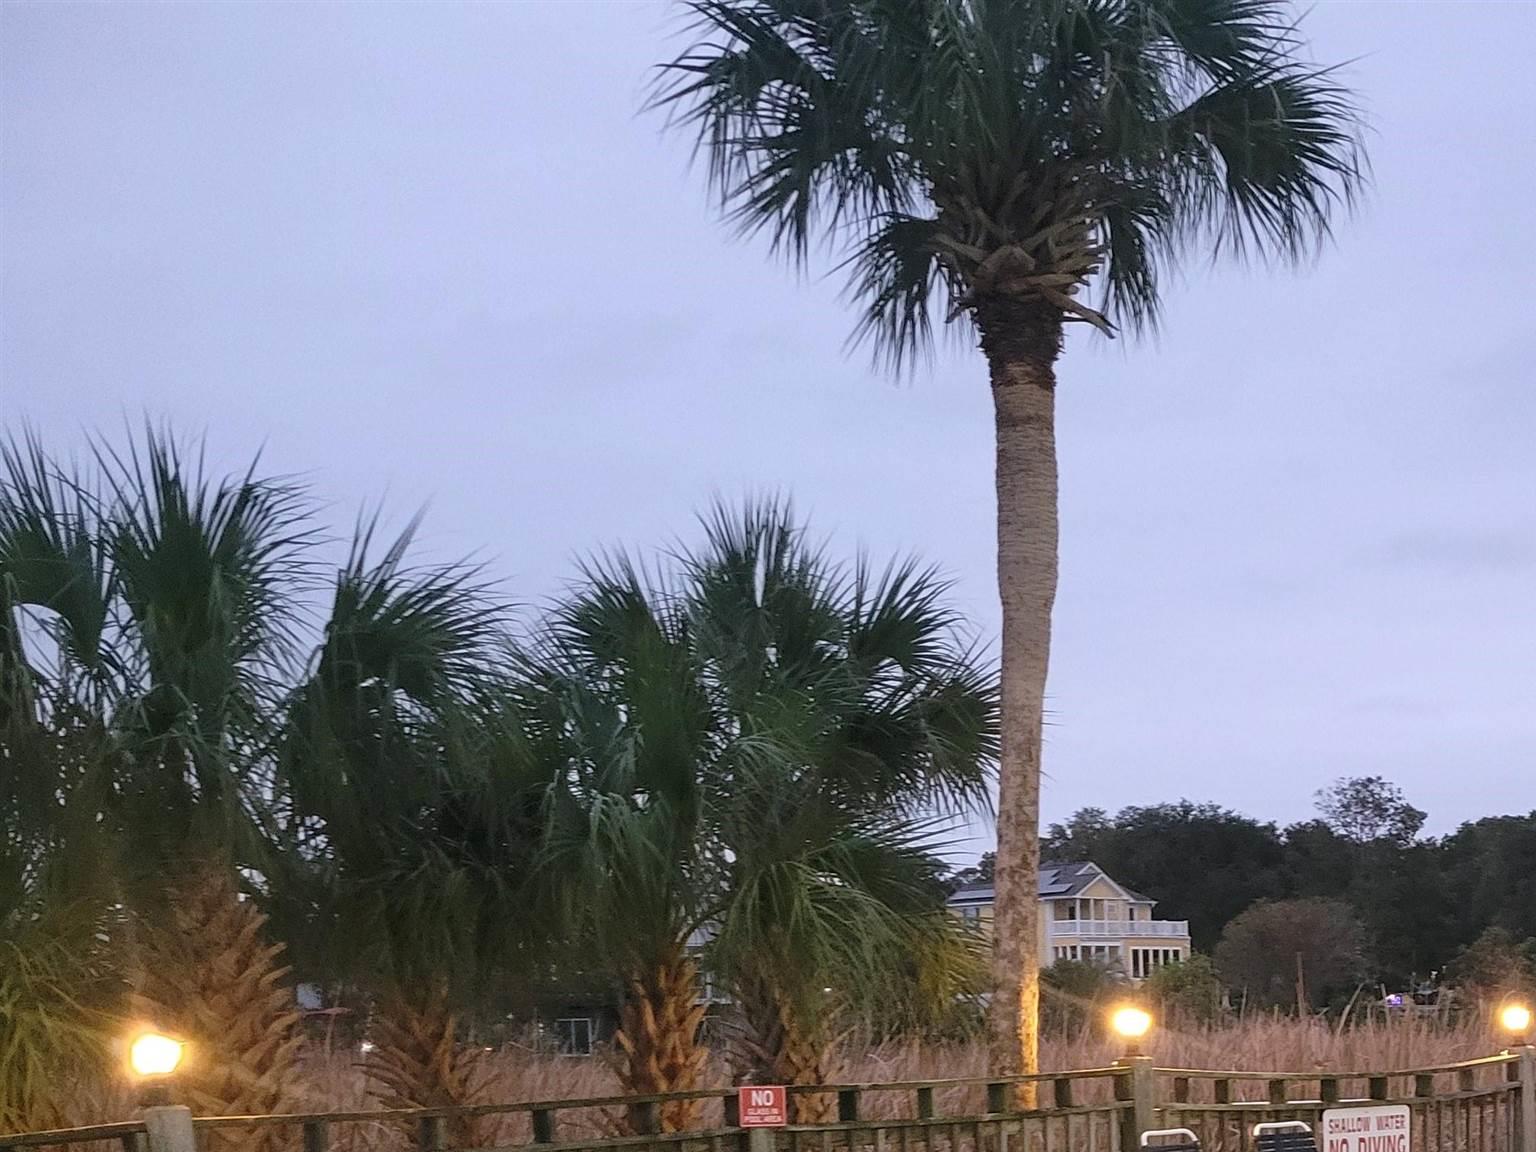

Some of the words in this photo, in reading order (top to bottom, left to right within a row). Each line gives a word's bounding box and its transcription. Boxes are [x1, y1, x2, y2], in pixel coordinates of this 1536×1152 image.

[751, 1090, 774, 1106] NO
[1329, 1117, 1371, 1134] SHALLOW
[1376, 1115, 1405, 1130] WATER
